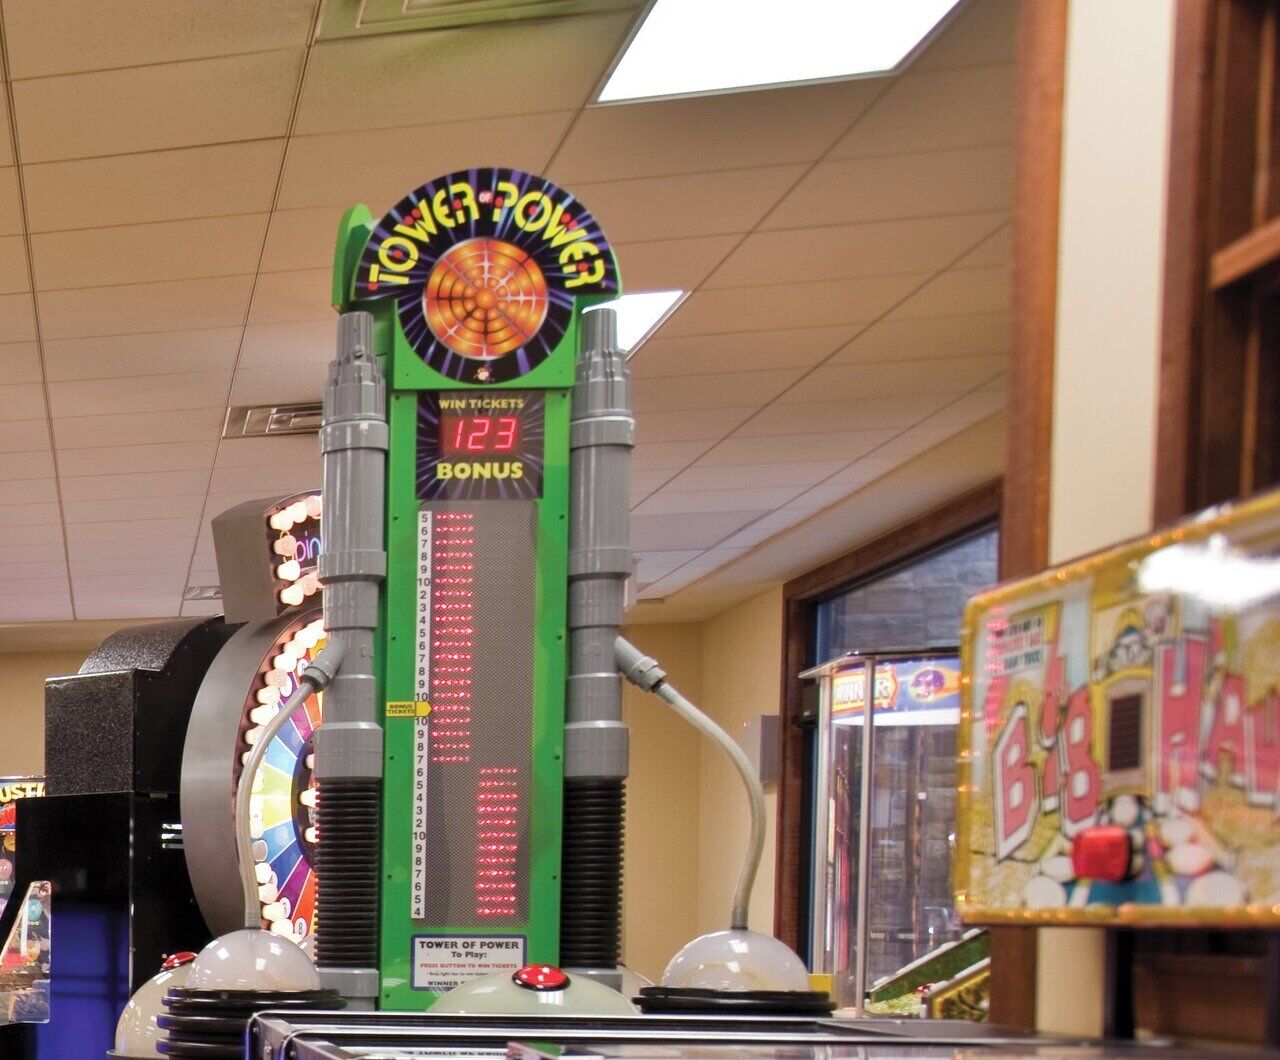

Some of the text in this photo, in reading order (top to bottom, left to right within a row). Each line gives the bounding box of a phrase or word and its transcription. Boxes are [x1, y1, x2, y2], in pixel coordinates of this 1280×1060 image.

[368, 181, 606, 292] TOWER OF POWER
[438, 398, 525, 410] WIN TICKETS
[454, 417, 518, 450] 123
[436, 461, 524, 480] BONUS
[421, 513, 428, 523] 5
[421, 526, 428, 536] 6
[421, 539, 428, 548] 7
[421, 552, 427, 561] 8
[420, 564, 427, 574] 9
[418, 577, 431, 587] 10
[420, 590, 427, 600] 2
[420, 603, 426, 613] 3
[420, 616, 426, 625] 4
[419, 628, 426, 638] 5
[419, 641, 425, 651] 6
[419, 654, 425, 663] 7
[419, 667, 425, 676] 8
[419, 680, 425, 689] 9
[415, 693, 428, 701] 10
[414, 717, 428, 727] 10
[417, 730, 424, 739] 9
[417, 743, 424, 752] 8
[417, 755, 423, 764] 7
[416, 768, 423, 777] 6
[416, 780, 423, 790] 5
[416, 793, 423, 802] 4
[416, 806, 422, 815] 3
[416, 819, 423, 828] 2
[413, 831, 426, 841] 10
[415, 844, 422, 853] 9
[415, 857, 422, 866] 8
[415, 869, 422, 879] 7
[414, 882, 422, 891] 6
[414, 894, 421, 904] 5
[414, 907, 421, 917] 4
[419, 940, 520, 950] TOWER OF POWER
[451, 950, 488, 960] To Play:
